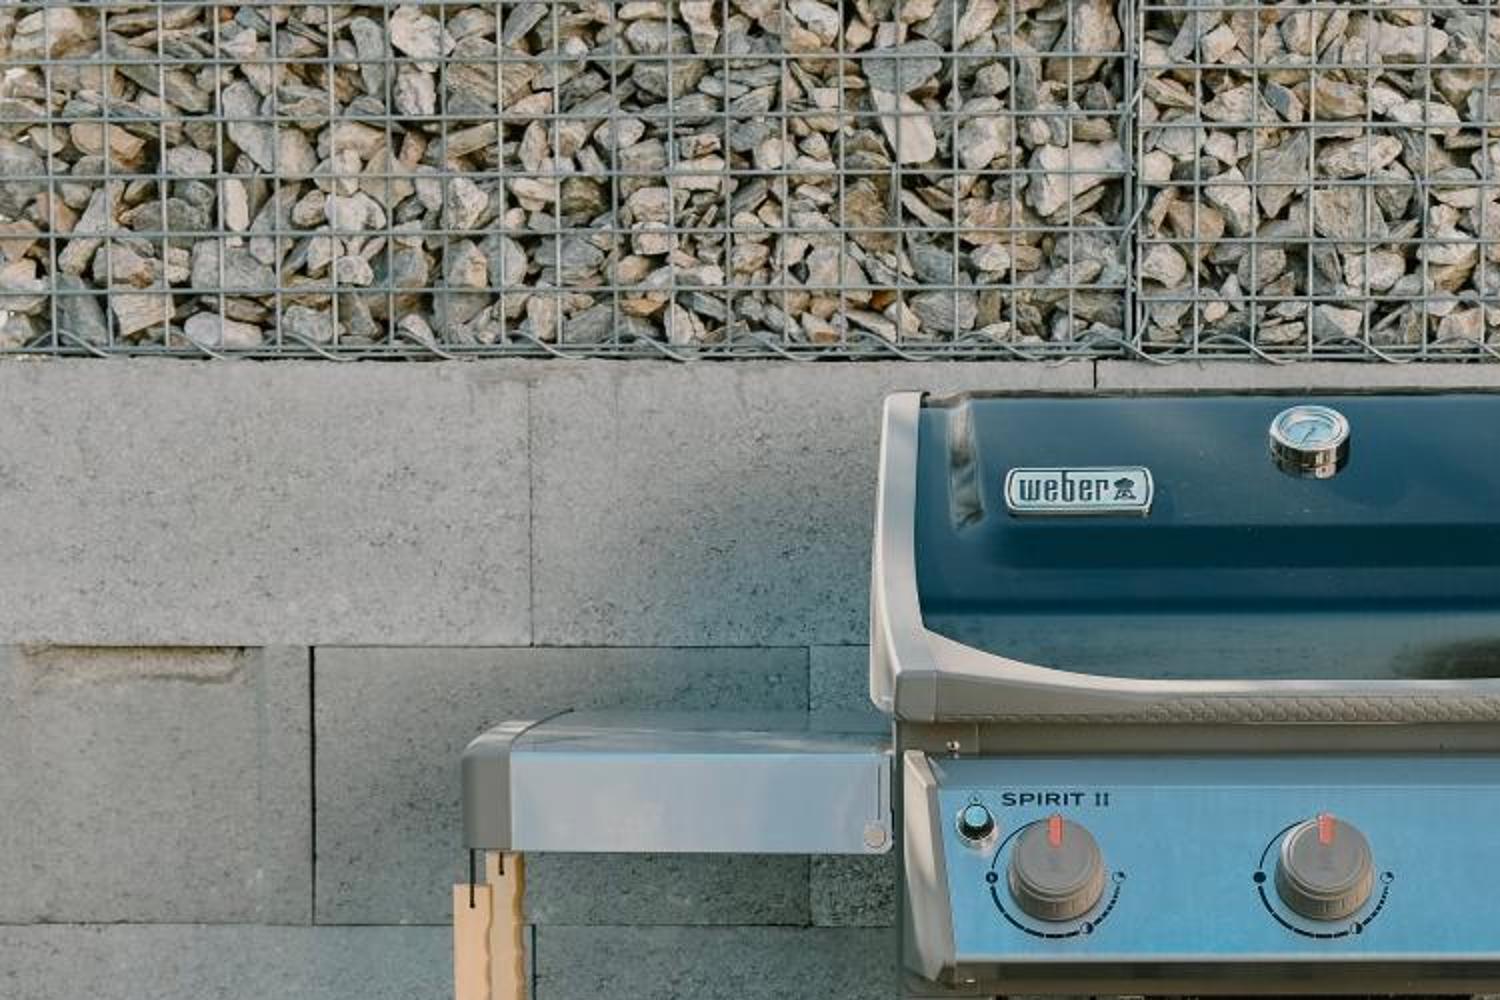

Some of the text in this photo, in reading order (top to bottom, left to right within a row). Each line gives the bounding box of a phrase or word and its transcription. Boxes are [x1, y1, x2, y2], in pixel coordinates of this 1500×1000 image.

[1019, 471, 1109, 502] weber
[1001, 792, 1109, 806] SPIRIT II
